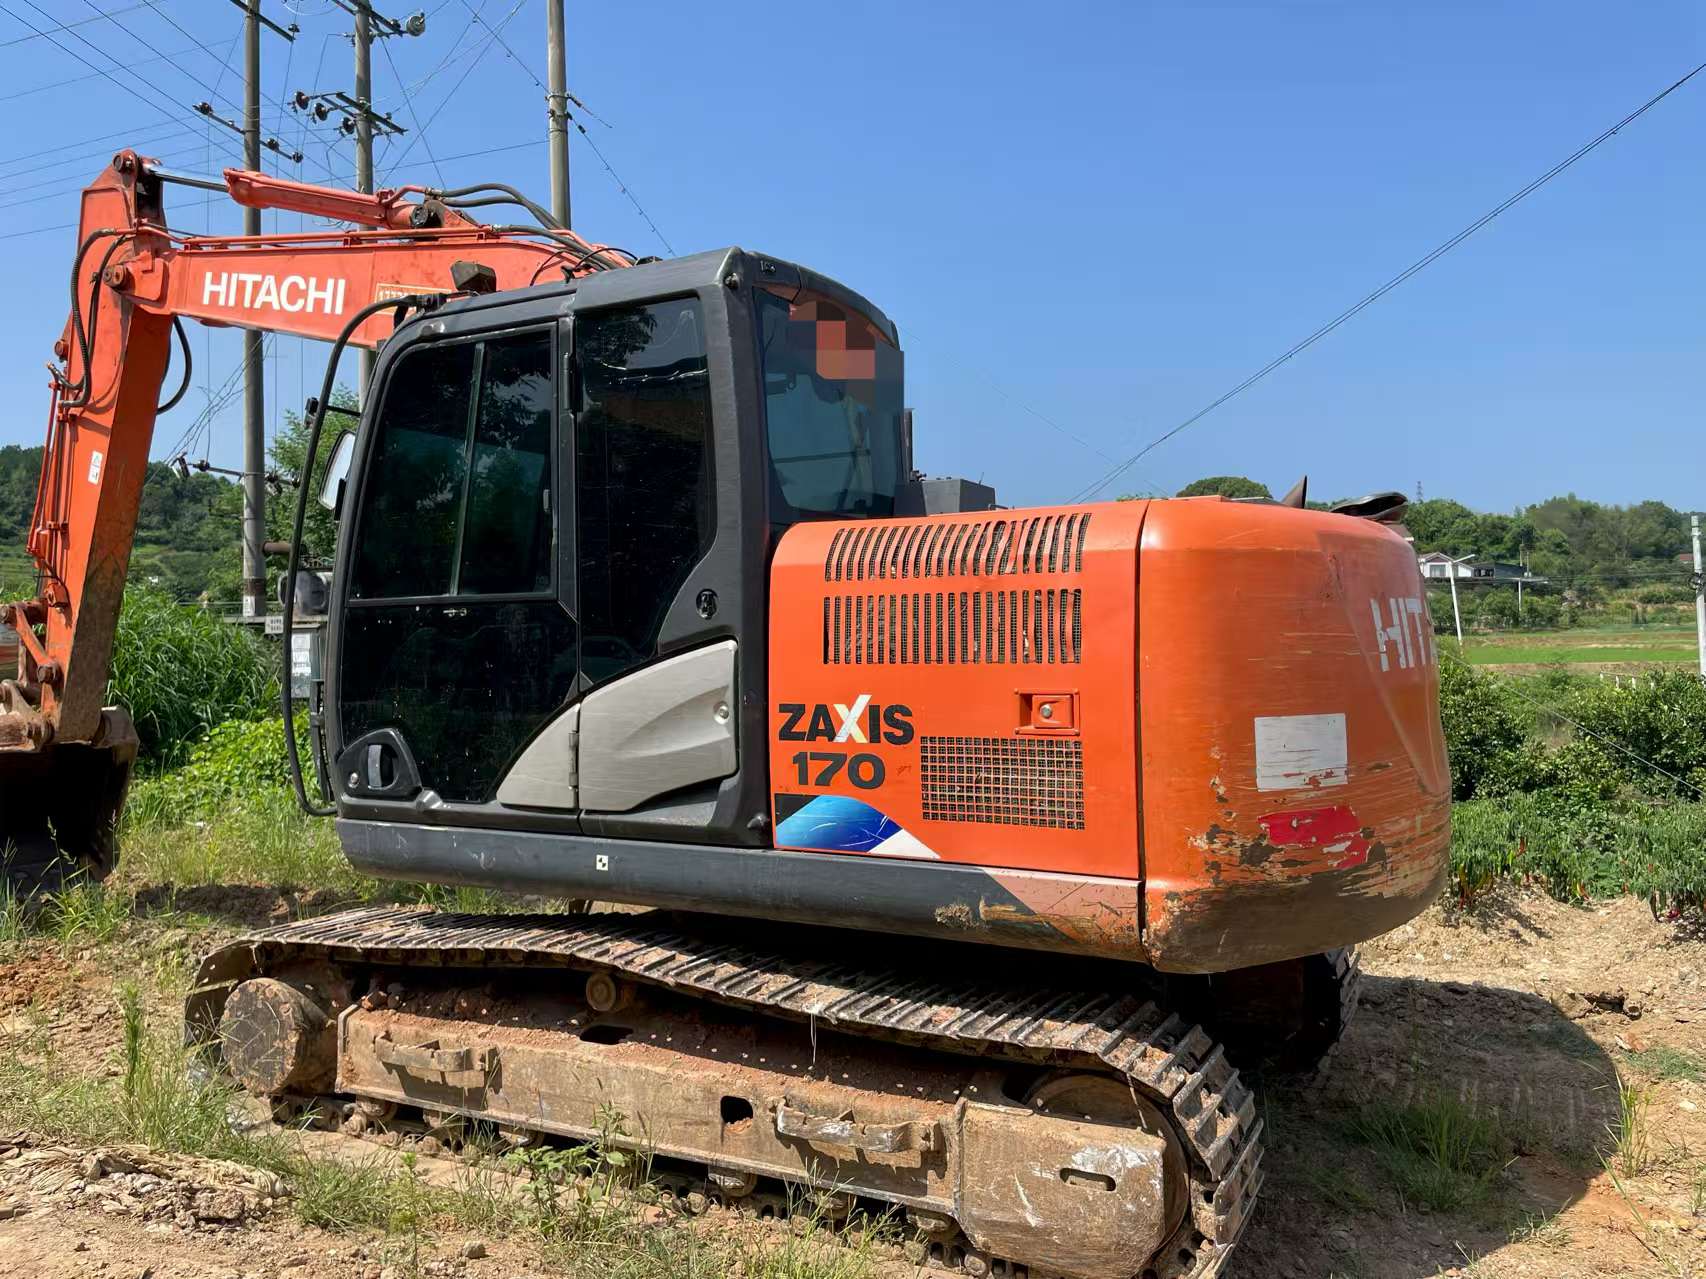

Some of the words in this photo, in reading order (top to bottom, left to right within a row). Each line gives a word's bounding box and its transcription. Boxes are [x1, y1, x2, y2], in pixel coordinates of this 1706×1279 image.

[202, 271, 346, 315] HITACHI
[1370, 597, 1438, 672] HIT
[778, 694, 915, 746] ZAXIS
[792, 751, 886, 789] 170
